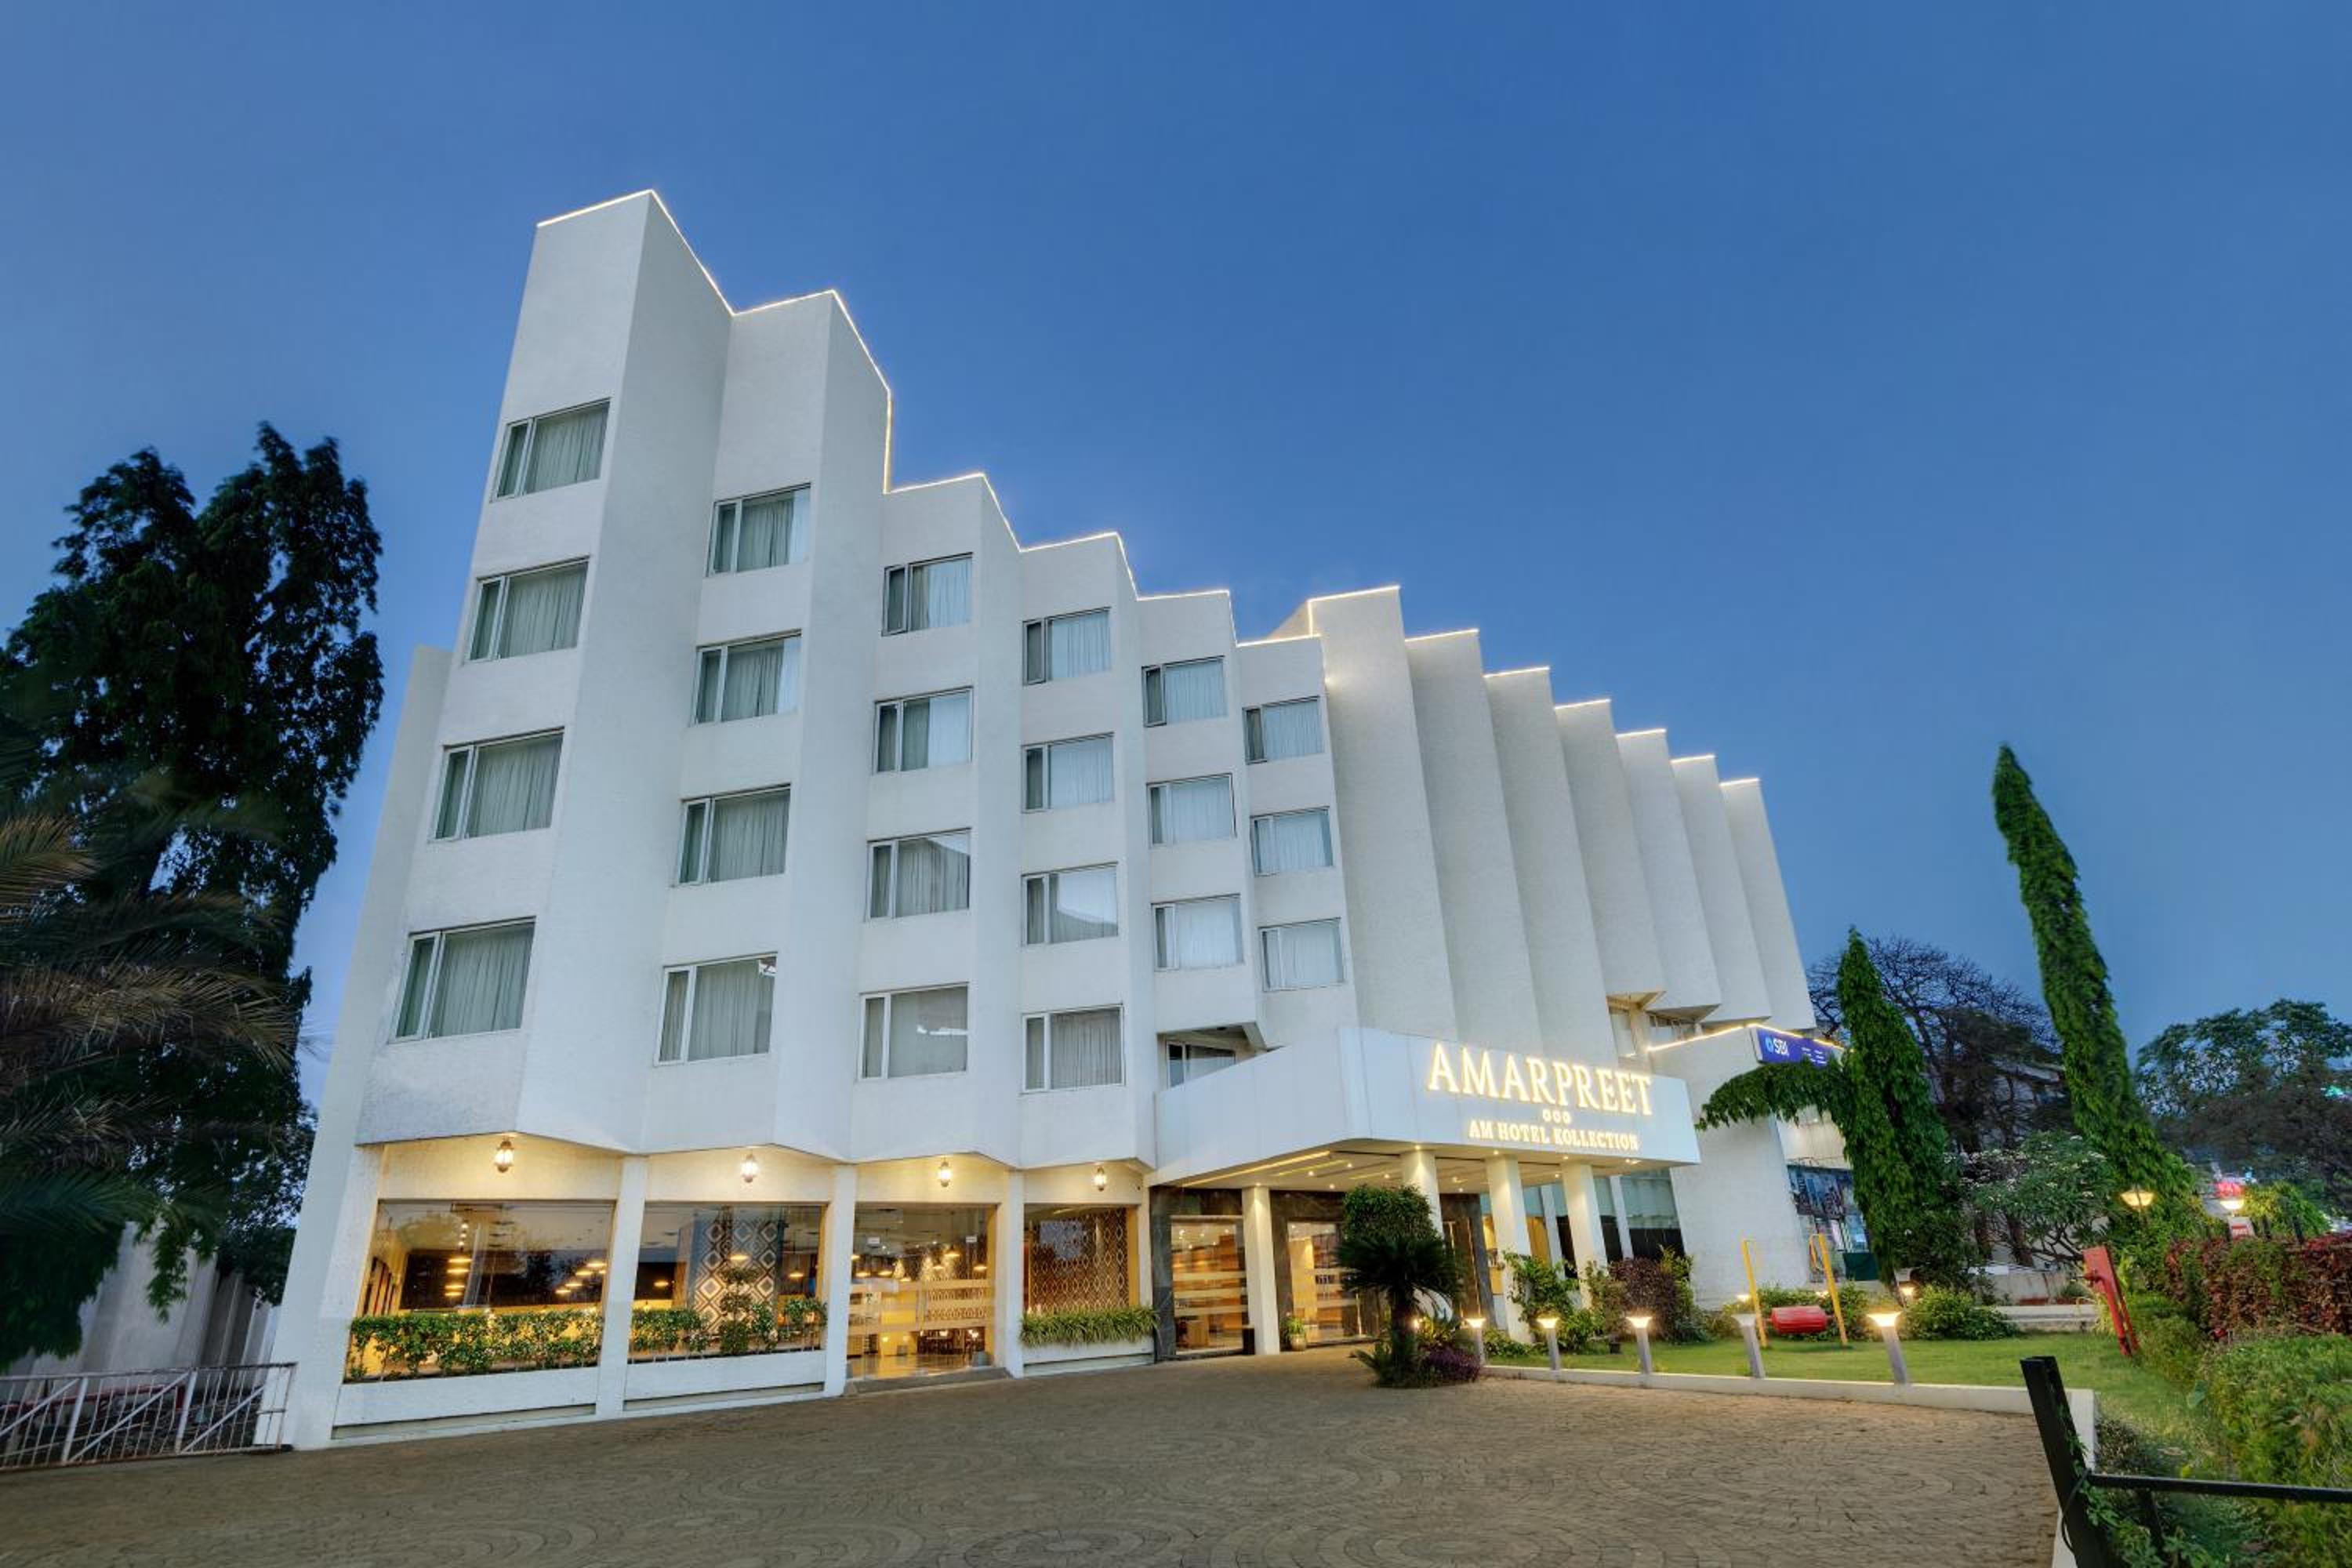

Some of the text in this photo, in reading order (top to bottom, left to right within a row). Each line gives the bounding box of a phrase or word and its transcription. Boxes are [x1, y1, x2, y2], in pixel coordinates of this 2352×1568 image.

[1428, 1042, 1653, 1115] AMARPREET
[1468, 1120, 1639, 1150] AM HOTEL KOLLECTION
